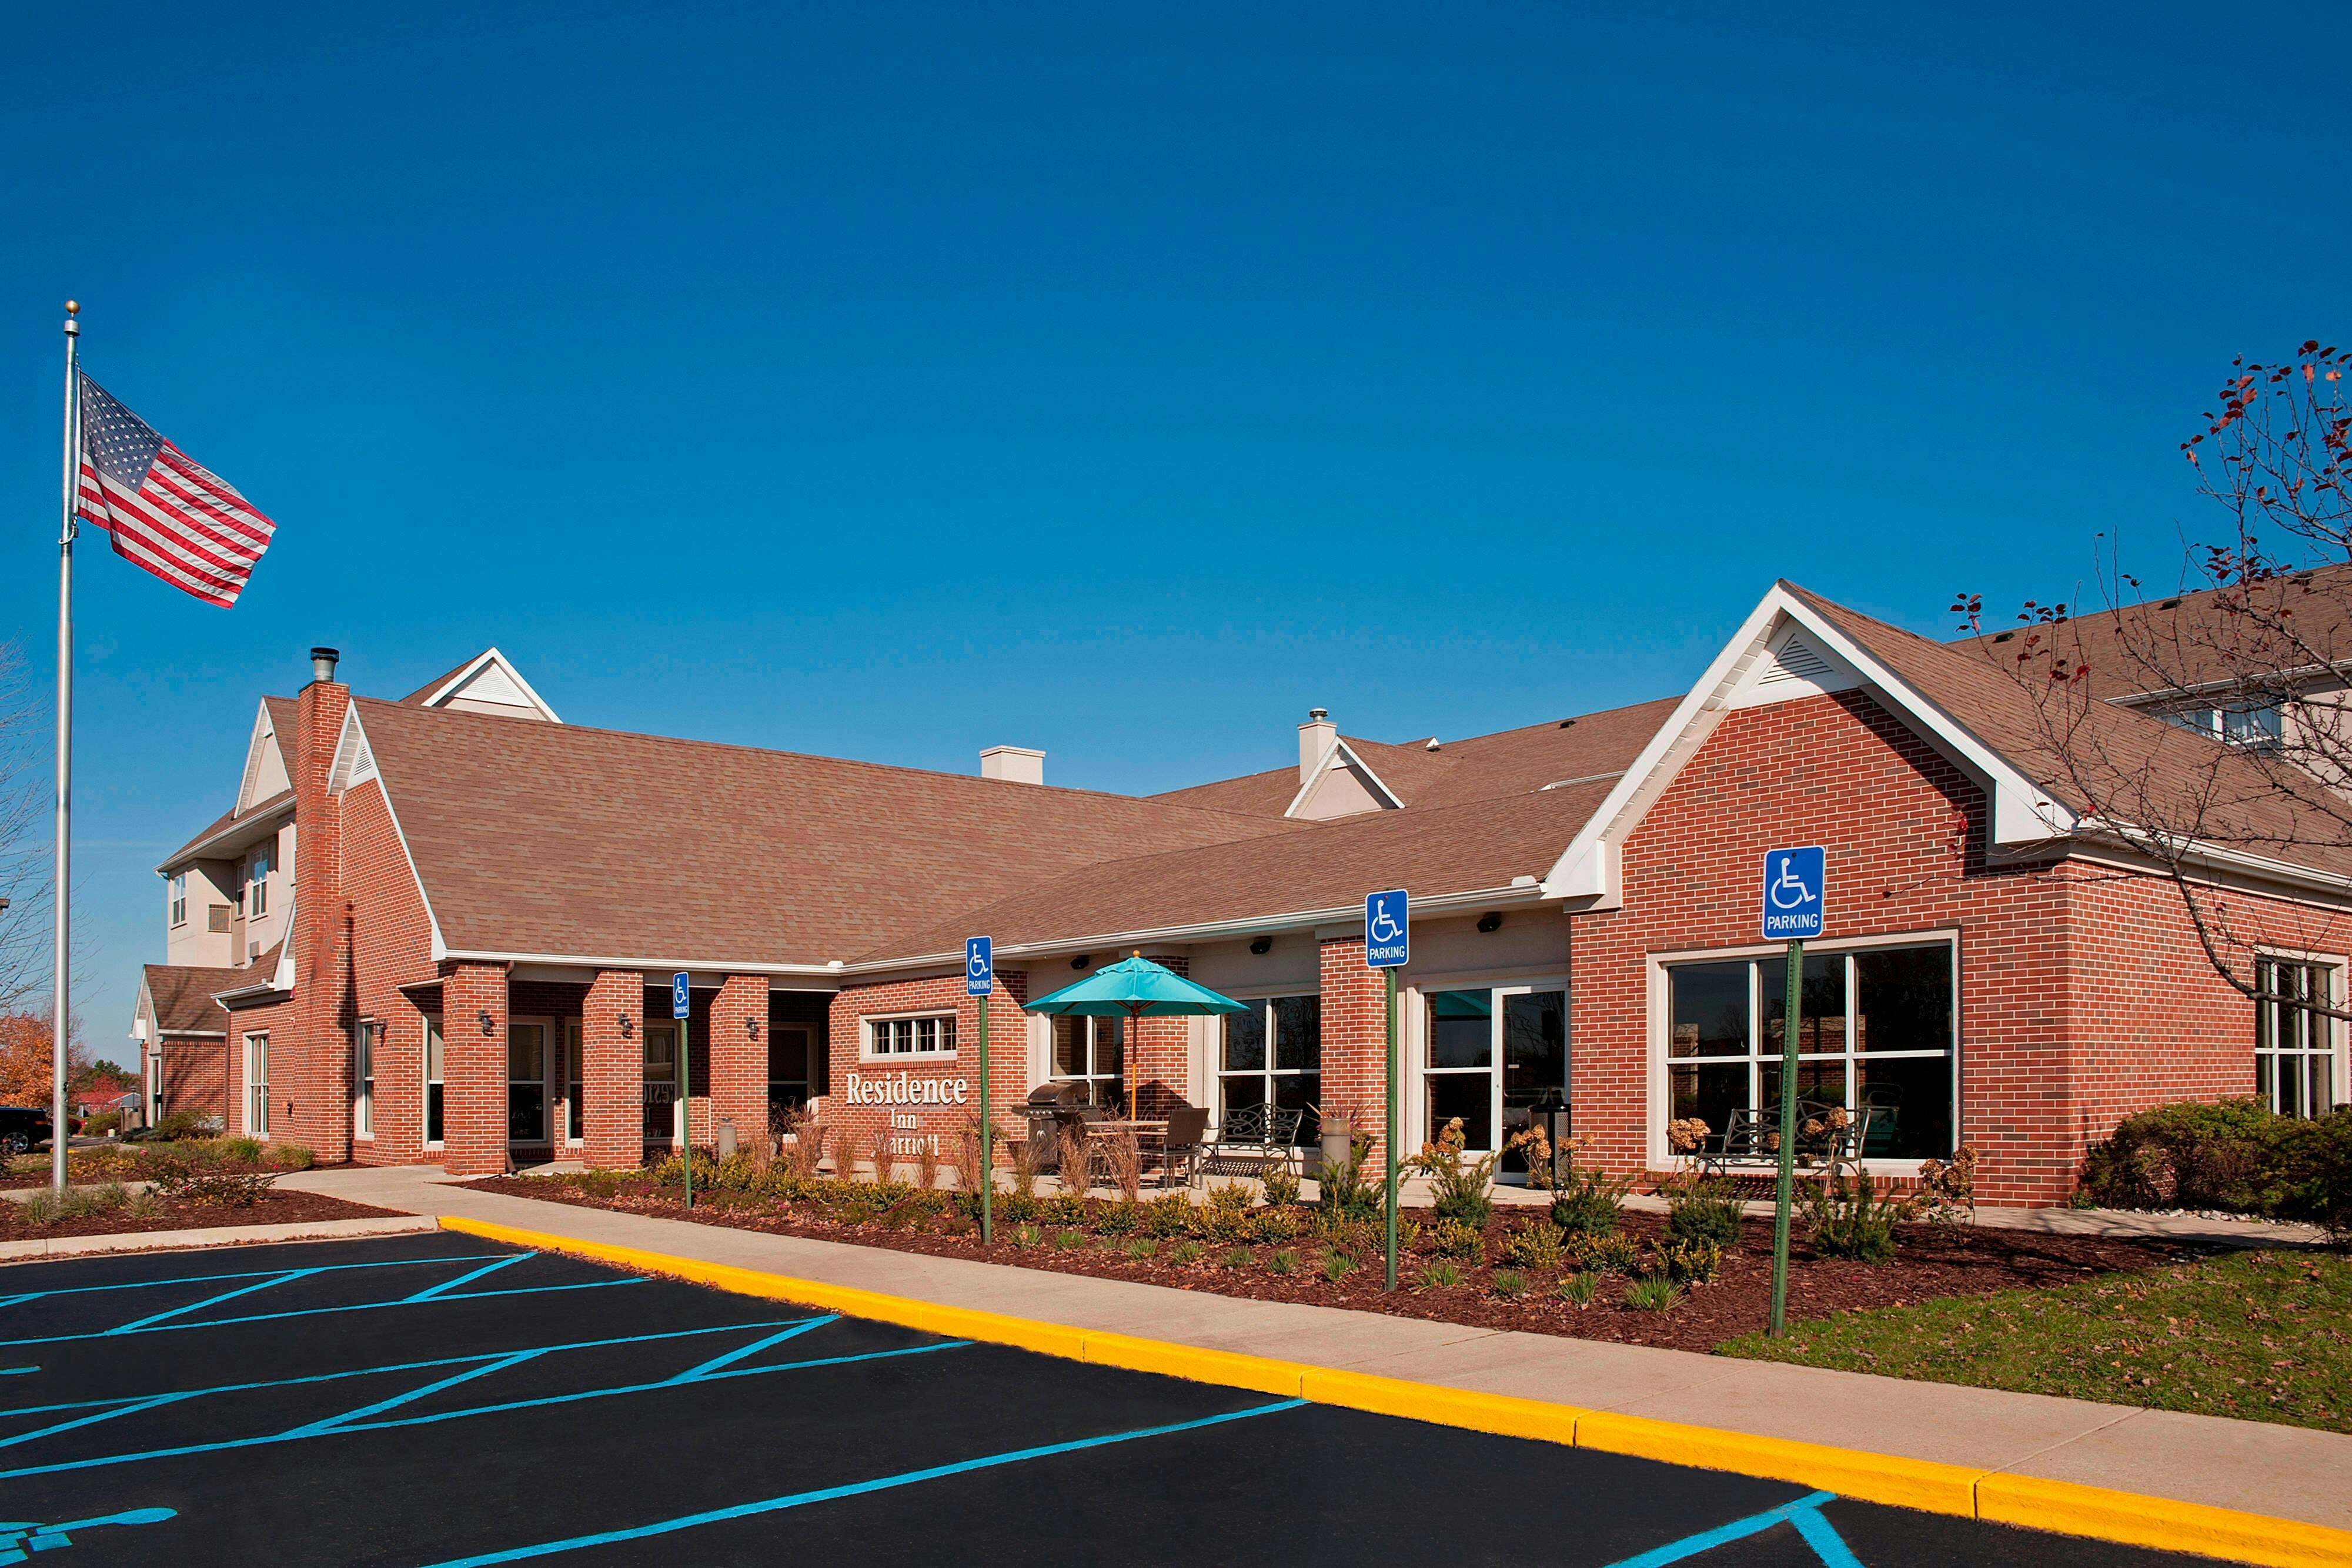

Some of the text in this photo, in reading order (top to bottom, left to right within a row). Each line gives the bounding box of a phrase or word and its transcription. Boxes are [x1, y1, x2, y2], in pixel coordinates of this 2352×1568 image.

[1768, 913, 1818, 930] PARKING
[1369, 945, 1405, 960] PARKING
[968, 979, 991, 990] PARKING
[846, 1071, 967, 1104] Residence
[890, 1108, 917, 1129] Inn
